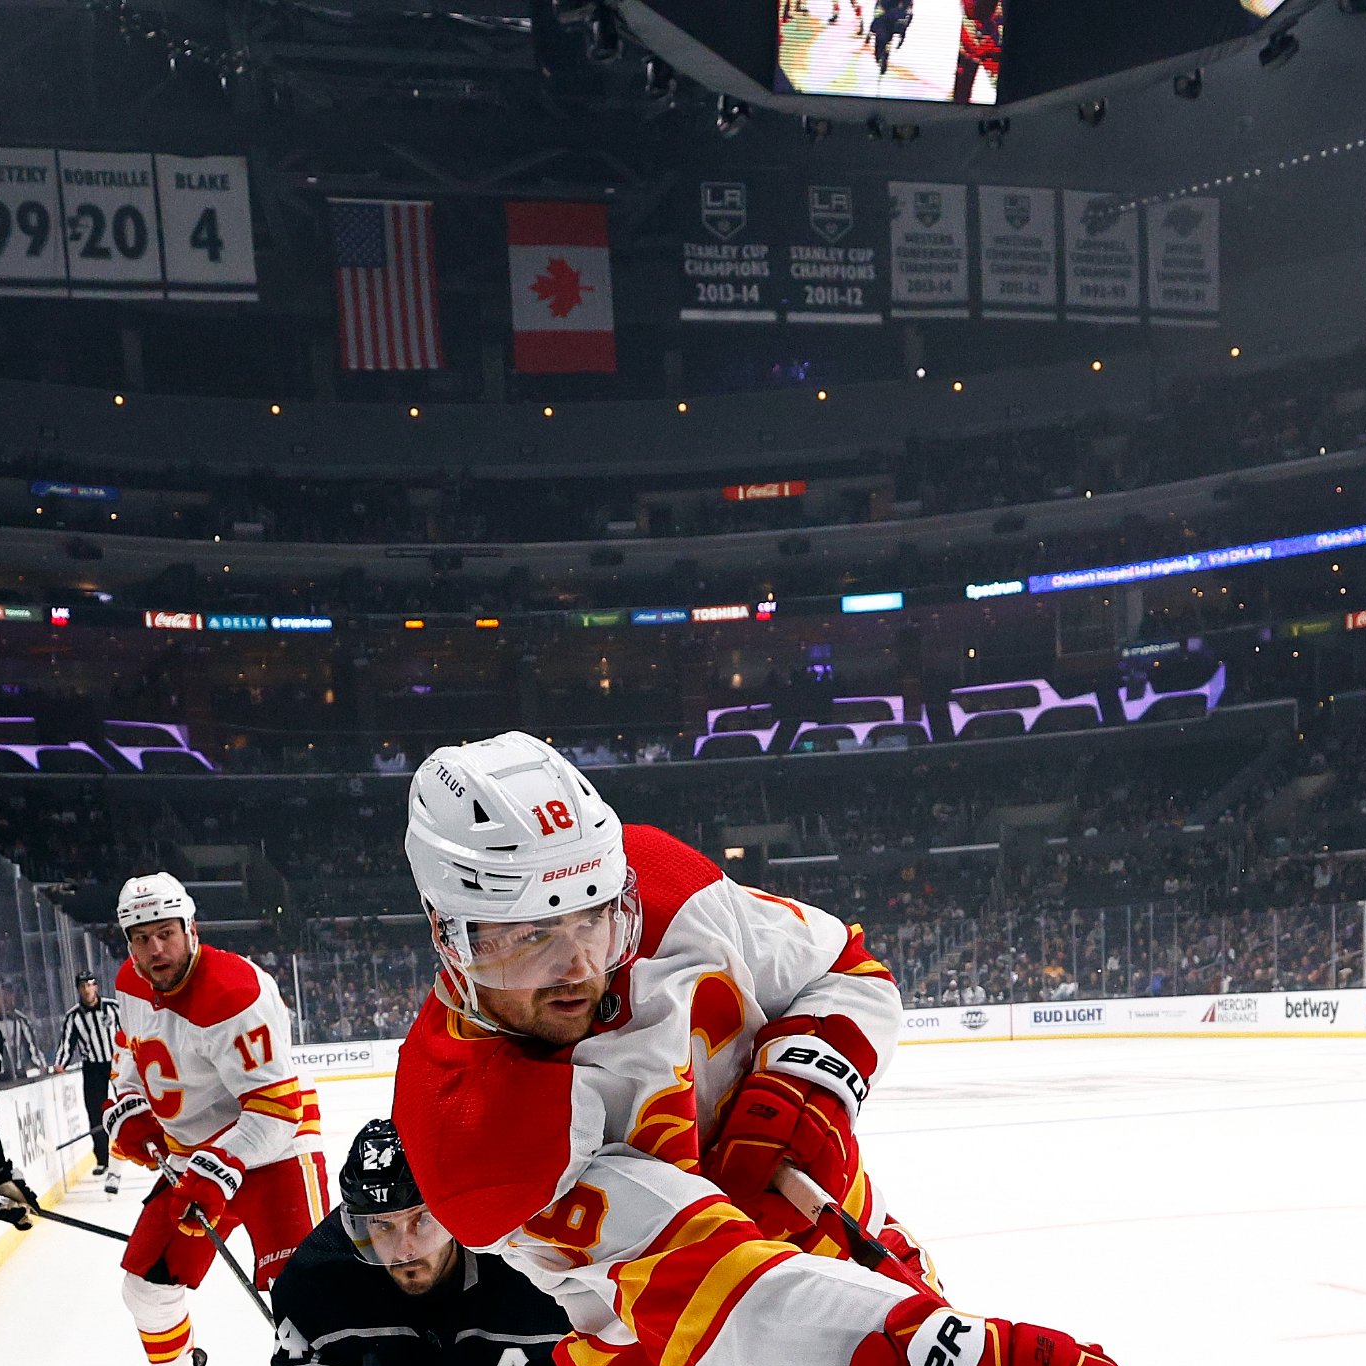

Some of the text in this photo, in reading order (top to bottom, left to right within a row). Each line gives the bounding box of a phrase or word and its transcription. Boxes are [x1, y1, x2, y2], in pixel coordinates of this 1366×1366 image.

[63, 168, 150, 188] ROBITAILLE
[175, 172, 230, 192] BLAKE
[76, 203, 149, 260] 20
[189, 207, 223, 263] 4
[685, 243, 769, 259] STANLEY CUP
[791, 246, 874, 262] STANLEY CUP
[685, 260, 770, 277] CHAMPIONS
[791, 263, 876, 280] CHAMPIONS
[696, 283, 760, 303] 2013-14
[804, 286, 864, 306] 2011-12
[966, 580, 1023, 599] Spectrum
[223, 617, 266, 627] DELTA
[280, 617, 332, 629] crypto.com
[692, 605, 749, 621] TOSHIBA
[435, 764, 466, 799] TELUS
[533, 799, 573, 836] 18
[541, 858, 602, 883] BAUER
[1218, 997, 1258, 1011] MERCURY
[1285, 997, 1339, 1023] betway
[1034, 1008, 1103, 1023] BUD LIGHT
[1218, 1011, 1258, 1023] INSURANCE
[233, 1024, 274, 1073] 17
[291, 1048, 370, 1066] nterprise
[776, 1046, 865, 1102] BAU
[363, 1139, 395, 1171] 24
